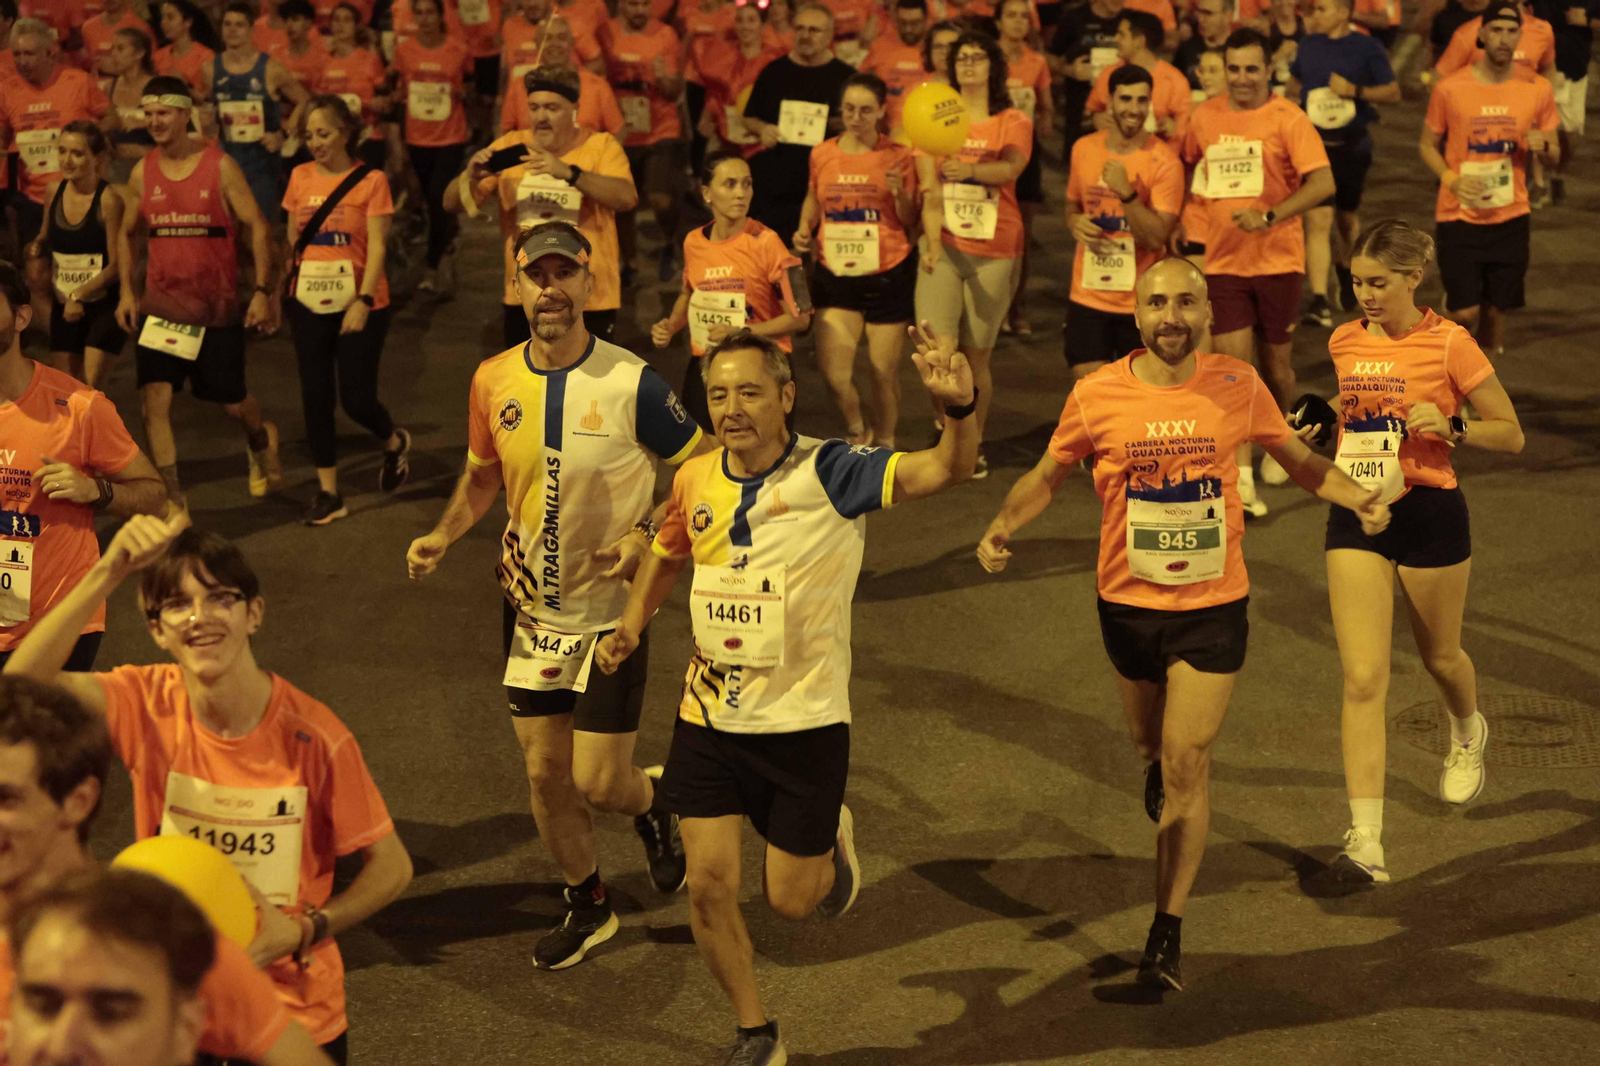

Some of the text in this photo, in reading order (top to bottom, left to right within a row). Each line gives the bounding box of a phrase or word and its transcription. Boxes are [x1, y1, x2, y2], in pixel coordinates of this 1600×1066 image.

[1219, 161, 1252, 174] 14422
[530, 191, 569, 205] 13726
[836, 243, 865, 255] 9170
[705, 266, 733, 279] XXXV
[306, 280, 344, 291] 20976
[1352, 361, 1396, 375] XXXV
[1367, 376, 1406, 385] NOCTURNA
[1145, 419, 1196, 438] XXXV
[1125, 437, 1216, 449] CARRERA NOCTURNA
[1132, 445, 1216, 458] GUADALQUIVIR
[1349, 461, 1385, 478] 10401
[543, 456, 562, 612] M.TRAGAMILLAS
[1158, 531, 1198, 550] 945
[706, 602, 762, 624] 14461
[189, 826, 275, 855] 11943
